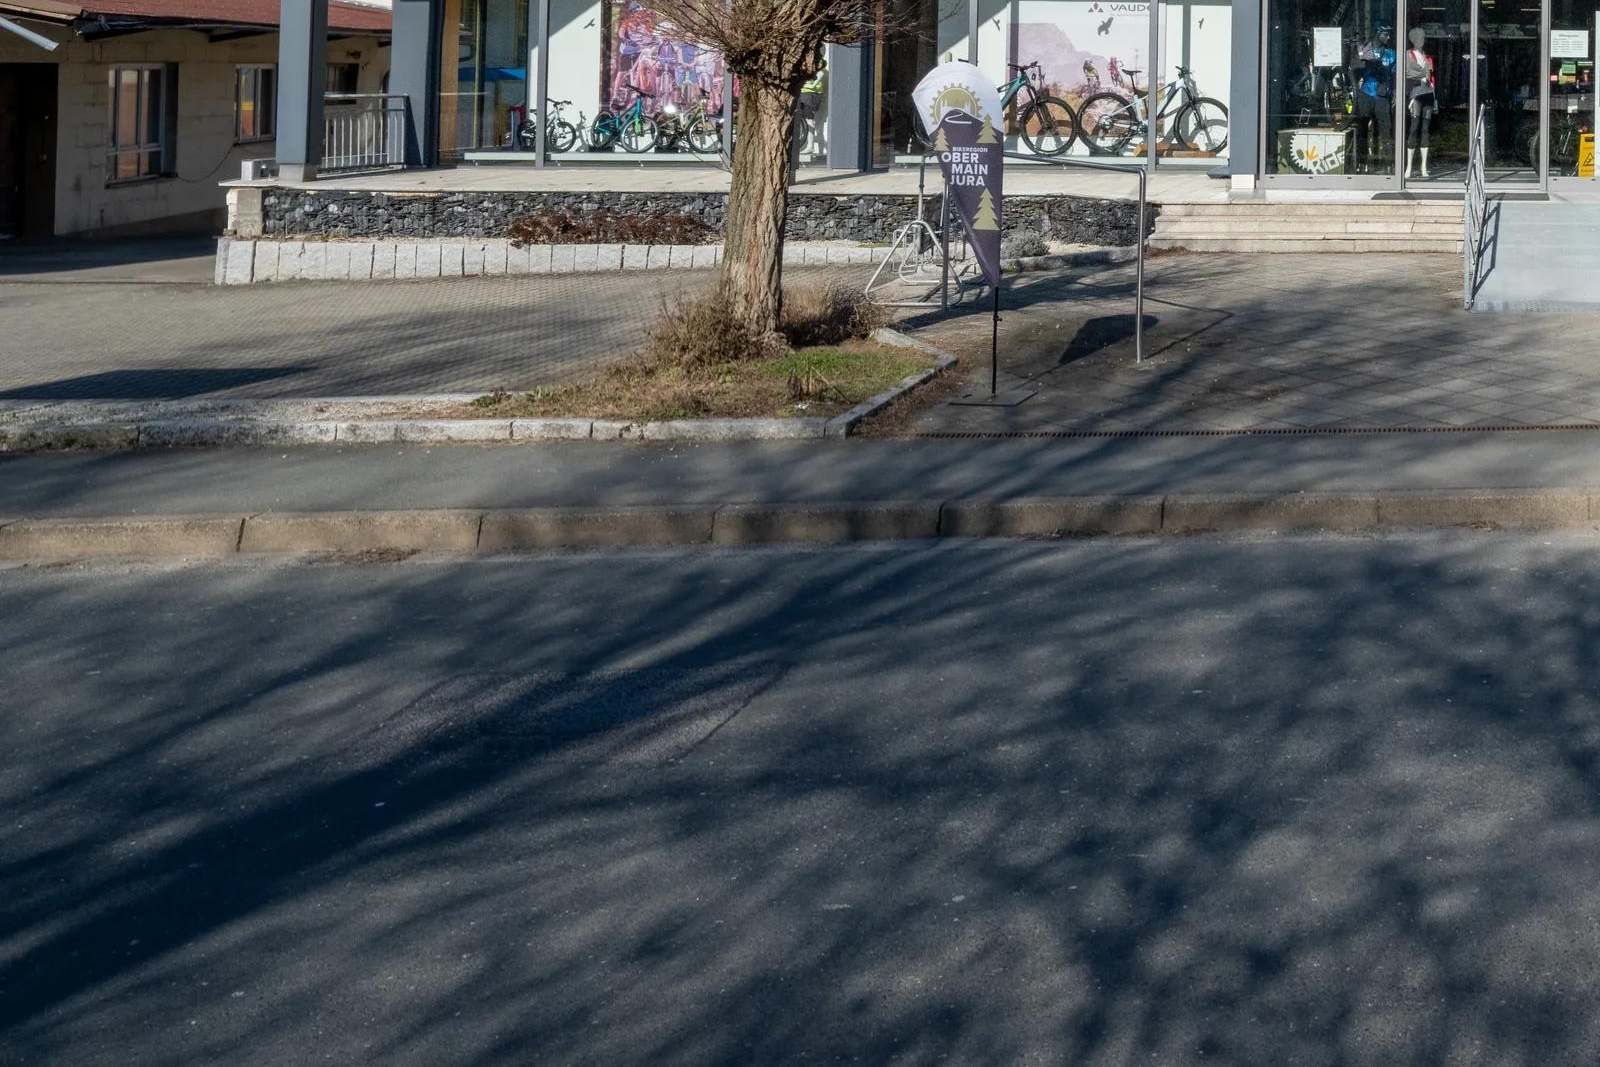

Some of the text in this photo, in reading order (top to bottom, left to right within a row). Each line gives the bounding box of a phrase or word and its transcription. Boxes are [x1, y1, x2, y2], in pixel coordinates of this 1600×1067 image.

[941, 152, 979, 163] OBER
[951, 164, 988, 175] MAIN
[949, 175, 985, 186] JURA
